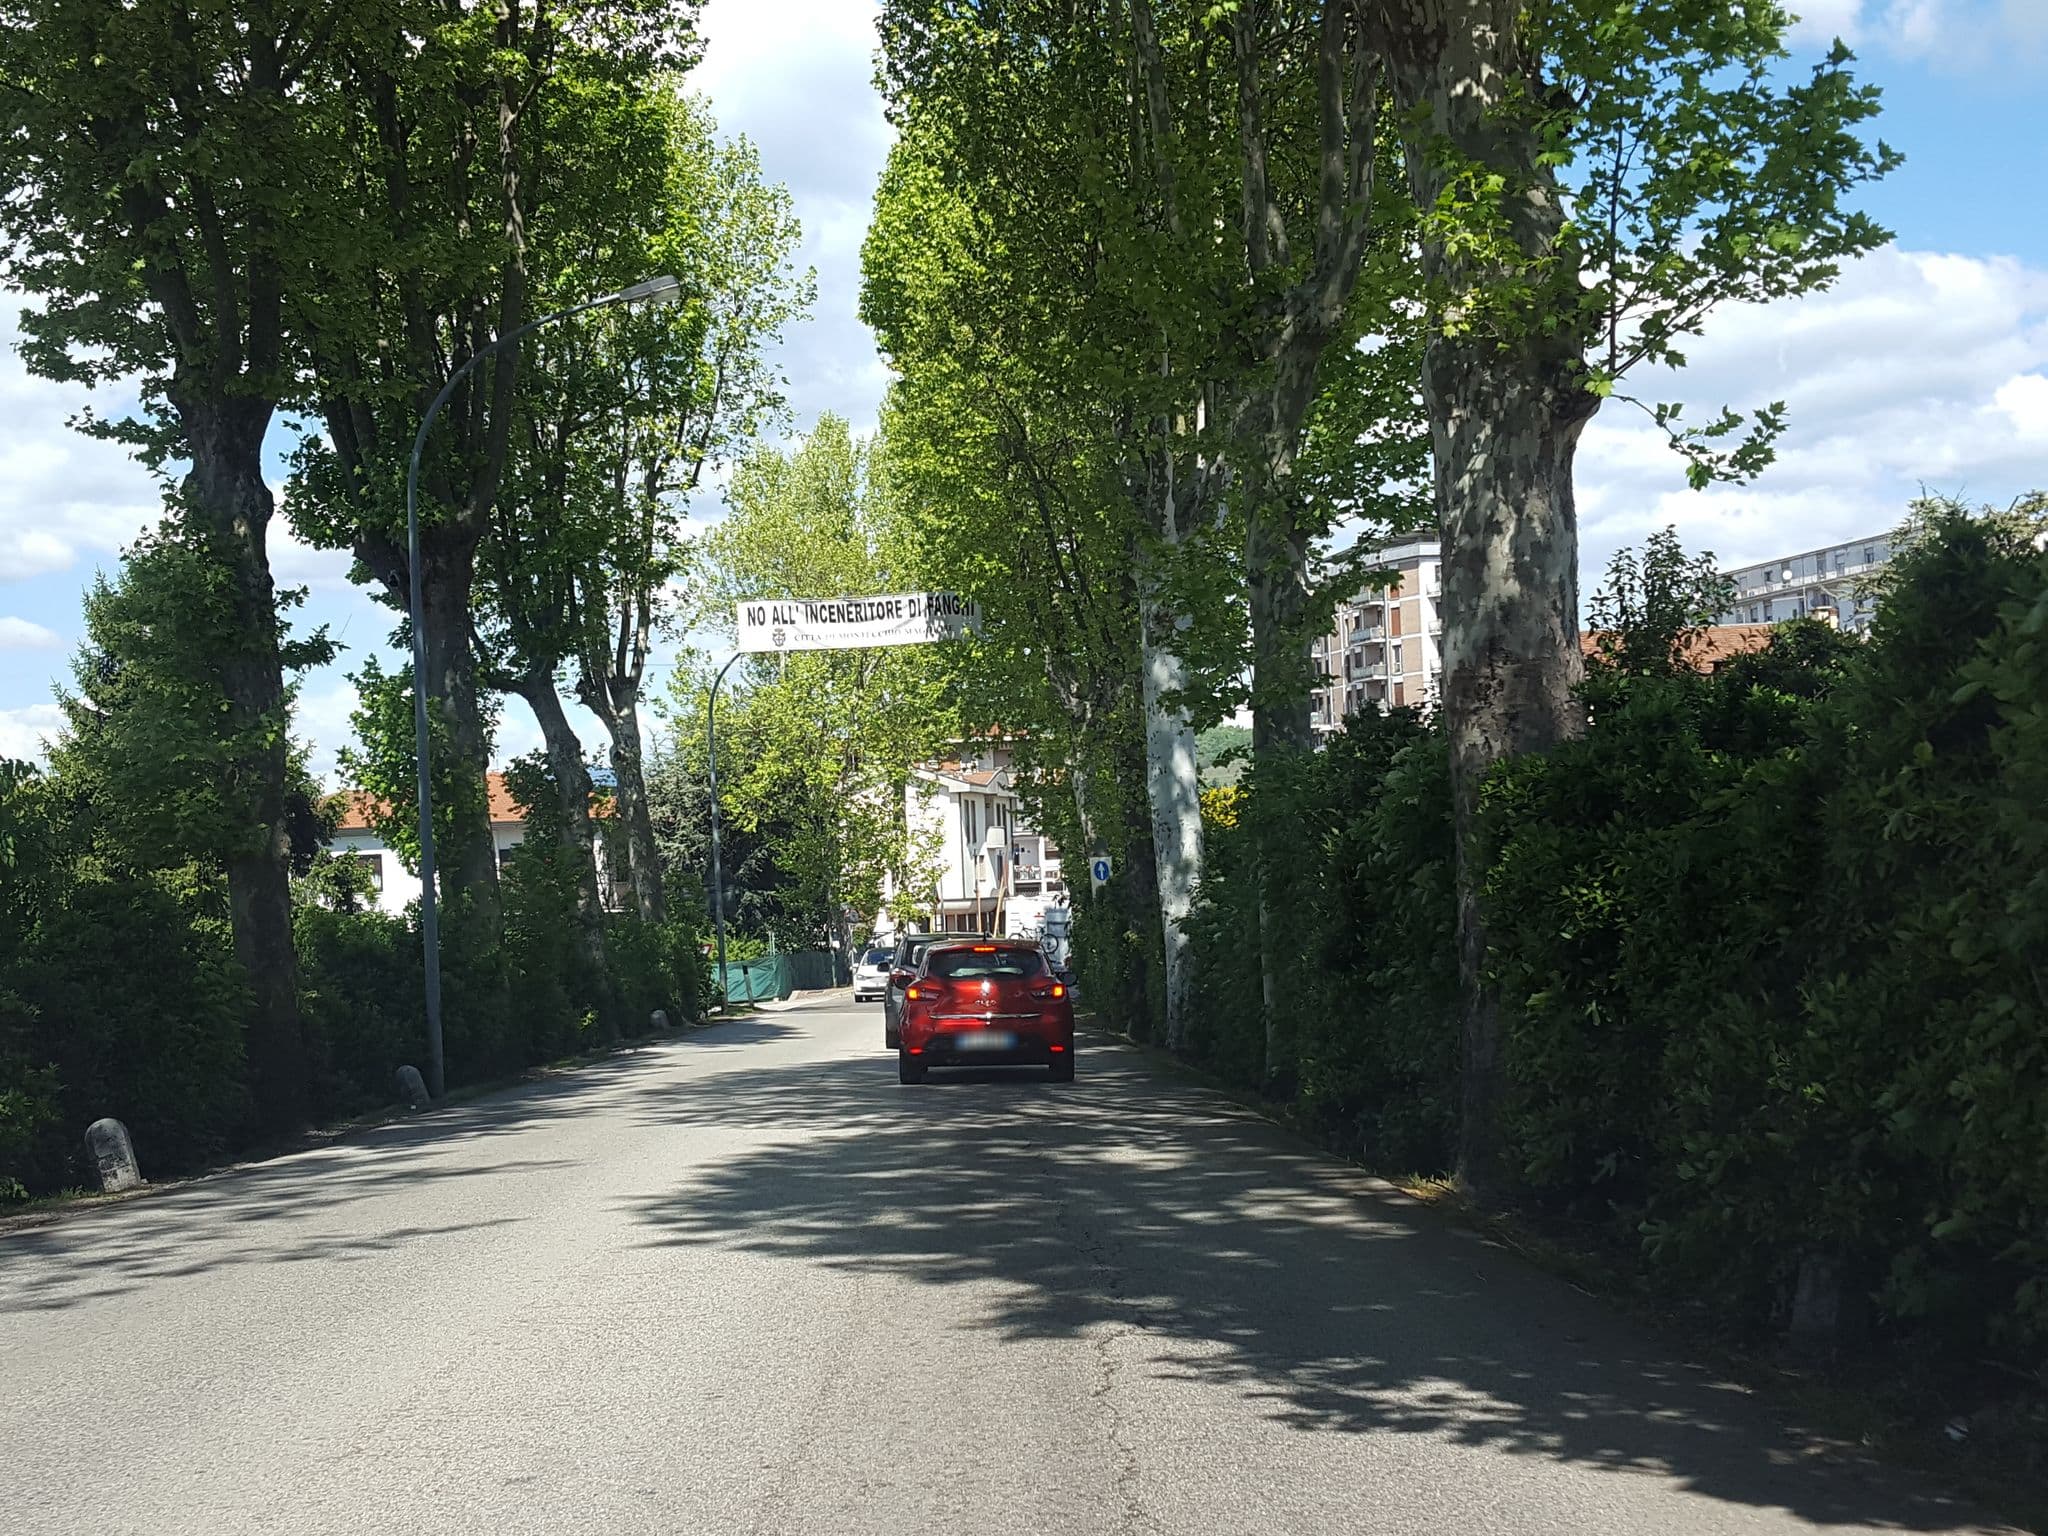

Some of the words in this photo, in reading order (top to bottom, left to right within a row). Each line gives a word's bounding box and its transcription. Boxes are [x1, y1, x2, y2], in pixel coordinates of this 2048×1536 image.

[747, 606, 766, 627] NO
[805, 600, 903, 624] INCENERITORE
[908, 598, 922, 618] DI
